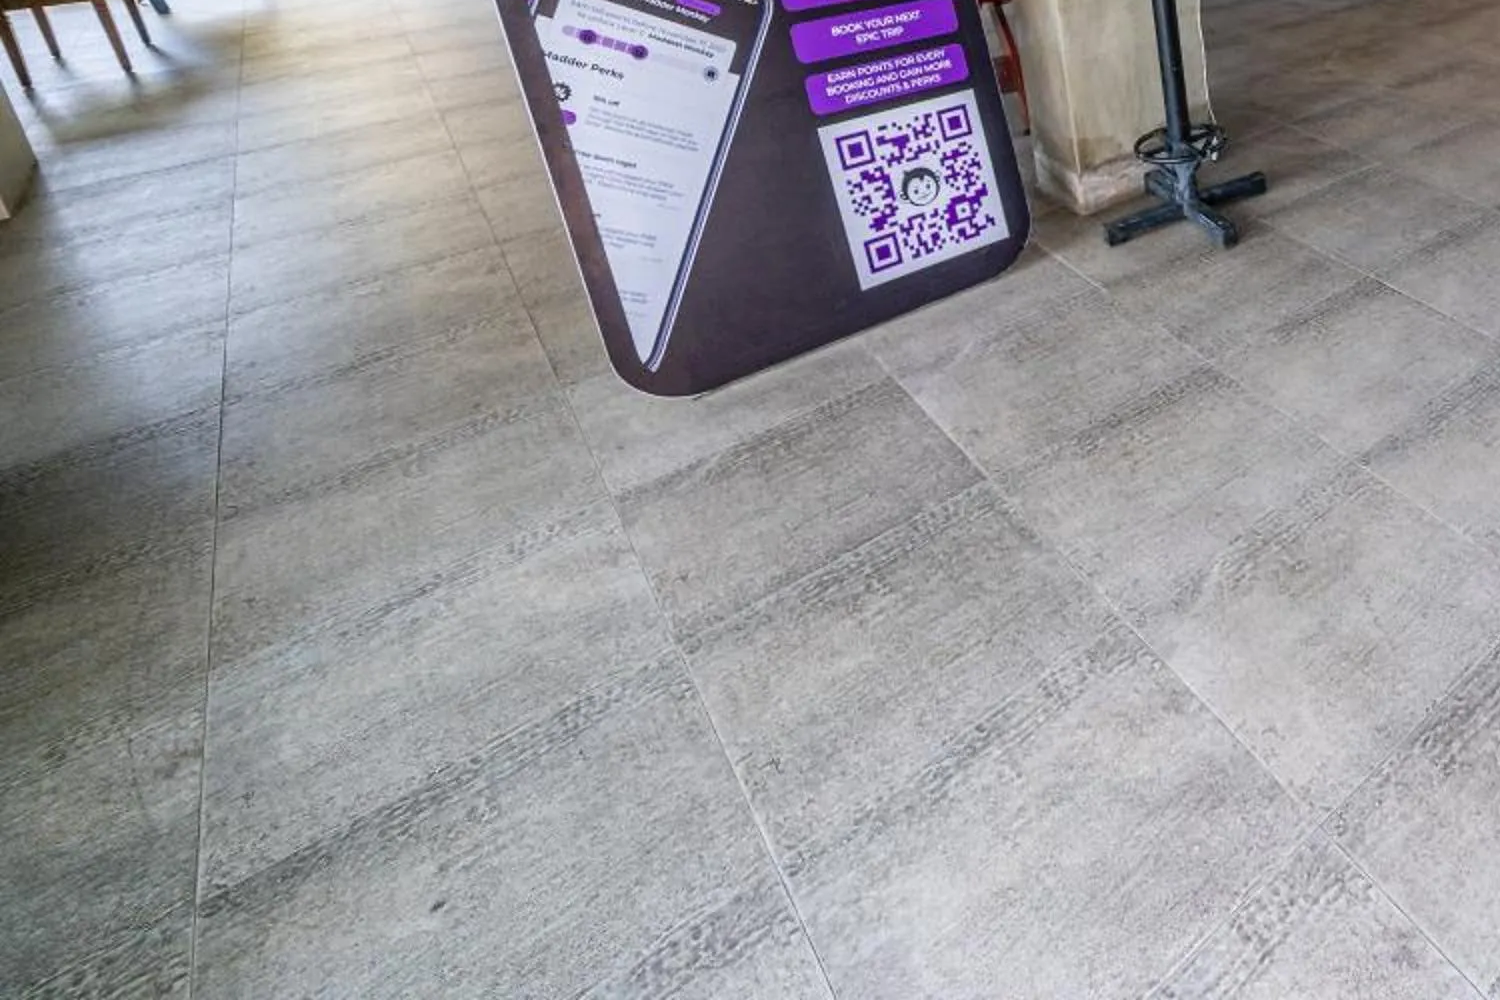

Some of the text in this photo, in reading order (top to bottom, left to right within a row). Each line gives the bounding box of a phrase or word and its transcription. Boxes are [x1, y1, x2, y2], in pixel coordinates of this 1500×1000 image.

[831, 10, 921, 37] BOOK YOUR NEXT
[855, 26, 905, 45] EPIC TRIP
[825, 59, 953, 97] BOOKING AND GAIN MORE
[827, 49, 946, 84] EARN POINTS FOR EVERY
[845, 83, 905, 105] DISCOUNTS
[911, 74, 941, 90] PERKS
